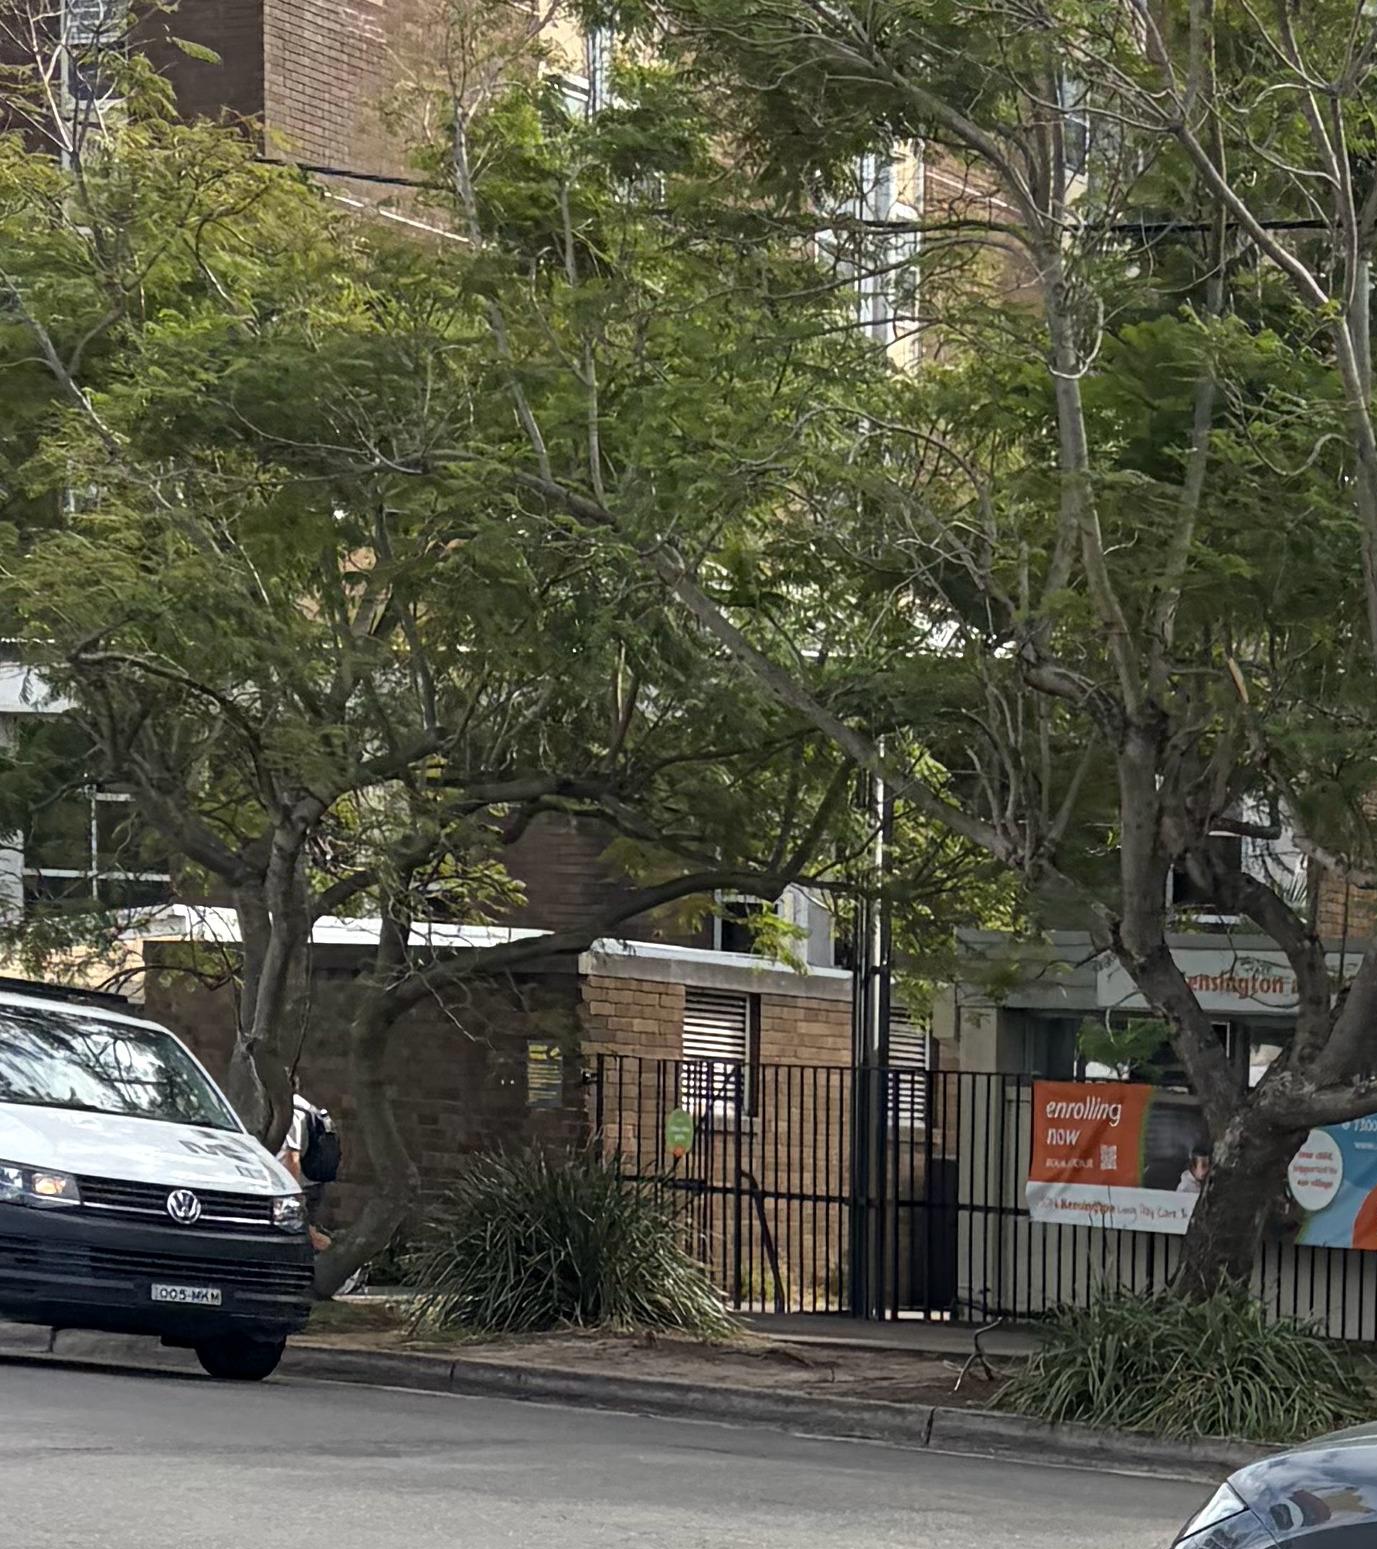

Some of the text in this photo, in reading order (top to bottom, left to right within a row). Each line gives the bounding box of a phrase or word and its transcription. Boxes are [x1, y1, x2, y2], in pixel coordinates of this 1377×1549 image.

[1184, 975, 1283, 999] ensington
[1046, 1095, 1122, 1127] enrolling
[1046, 1128, 1081, 1146] now
